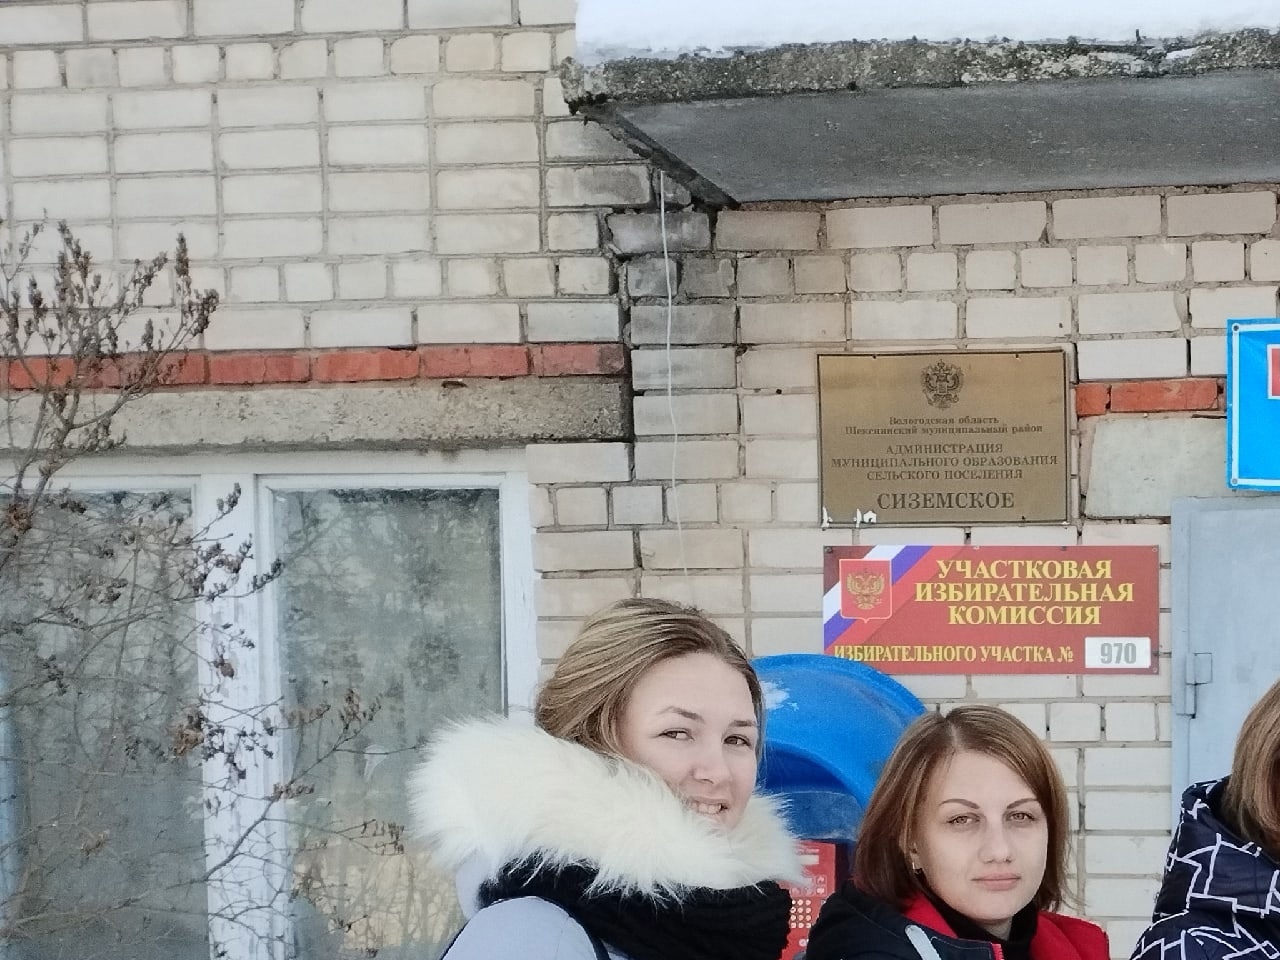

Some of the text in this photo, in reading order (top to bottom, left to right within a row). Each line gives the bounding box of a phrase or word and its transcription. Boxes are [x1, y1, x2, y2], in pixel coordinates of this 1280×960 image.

[886, 443, 1003, 456] АДМИНИСТРАЦИЯ
[831, 455, 1058, 469] МУНИЦИПАЛЬНОГО ОБРАЗОВАНИЯ
[867, 468, 1023, 481] СЕЛЬСКОГО ПОСЕЛЕНИЯ
[877, 491, 1015, 510] СИЗЕМСКОЕ
[937, 559, 1112, 579] УЧАСТКОВАЯ
[914, 582, 1135, 602] ИЗБИРАТЕЛЬНАЯ
[948, 605, 1102, 625] КОМИССИЯ
[834, 645, 1075, 663] ИЗБИРАТЕЛЬНОГО УЧАСТКА №
[1099, 642, 1137, 664] 970
